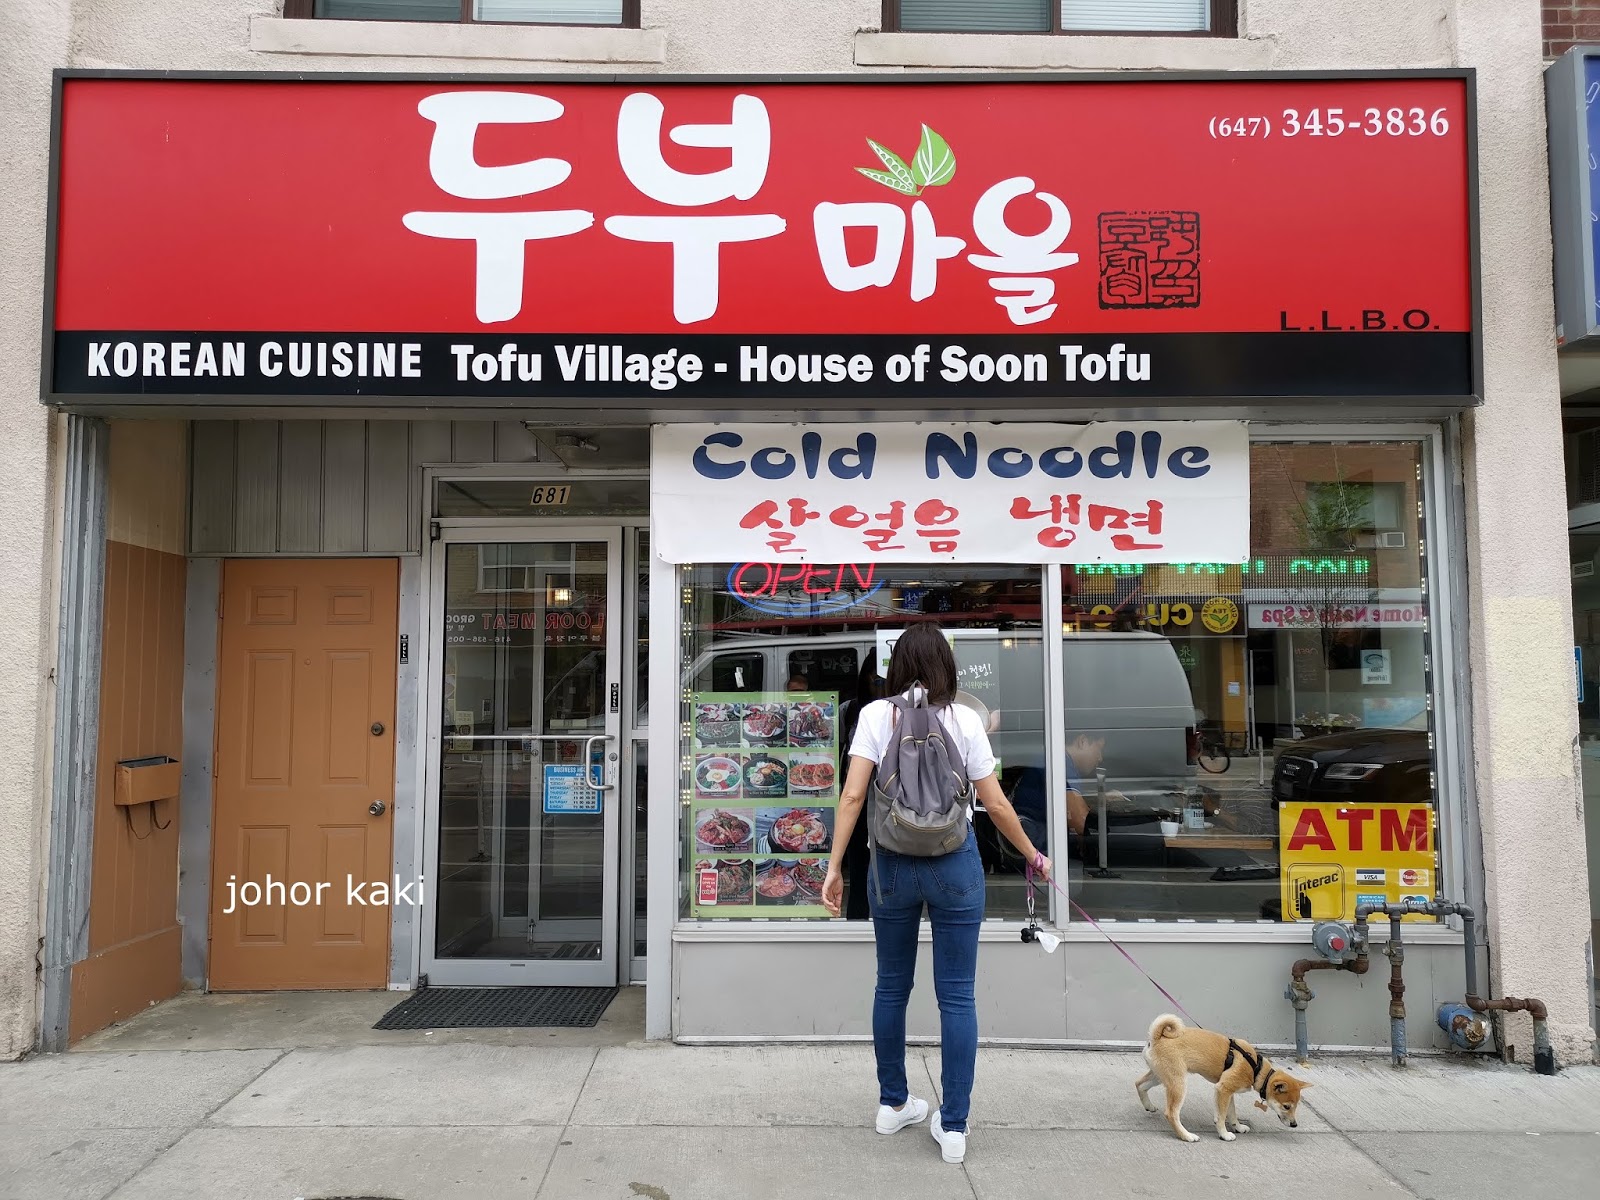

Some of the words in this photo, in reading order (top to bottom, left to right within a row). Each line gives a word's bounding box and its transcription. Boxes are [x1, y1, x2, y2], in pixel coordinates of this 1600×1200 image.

[1208, 114, 1272, 139] (647)
[1282, 107, 1449, 137] 345-3836
[402, 91, 787, 324] 두부
[814, 170, 1079, 326] 마을
[1281, 310, 1440, 331] L.L.B.O.
[88, 342, 245, 378] KOREAN
[259, 342, 422, 378] CUISINE
[450, 344, 542, 382] Tofu
[555, 345, 703, 390] Village
[740, 346, 874, 383] House
[886, 345, 931, 383] of
[940, 346, 1048, 383] Soon
[1060, 344, 1151, 382] Tofu
[692, 432, 877, 480] Cold
[925, 431, 1211, 480] Noodle
[532, 487, 568, 504] 681
[739, 498, 960, 553] 살얼음
[1010, 494, 1163, 551] 냉면
[734, 562, 877, 598] OPEN
[1287, 808, 1428, 851] ATM
